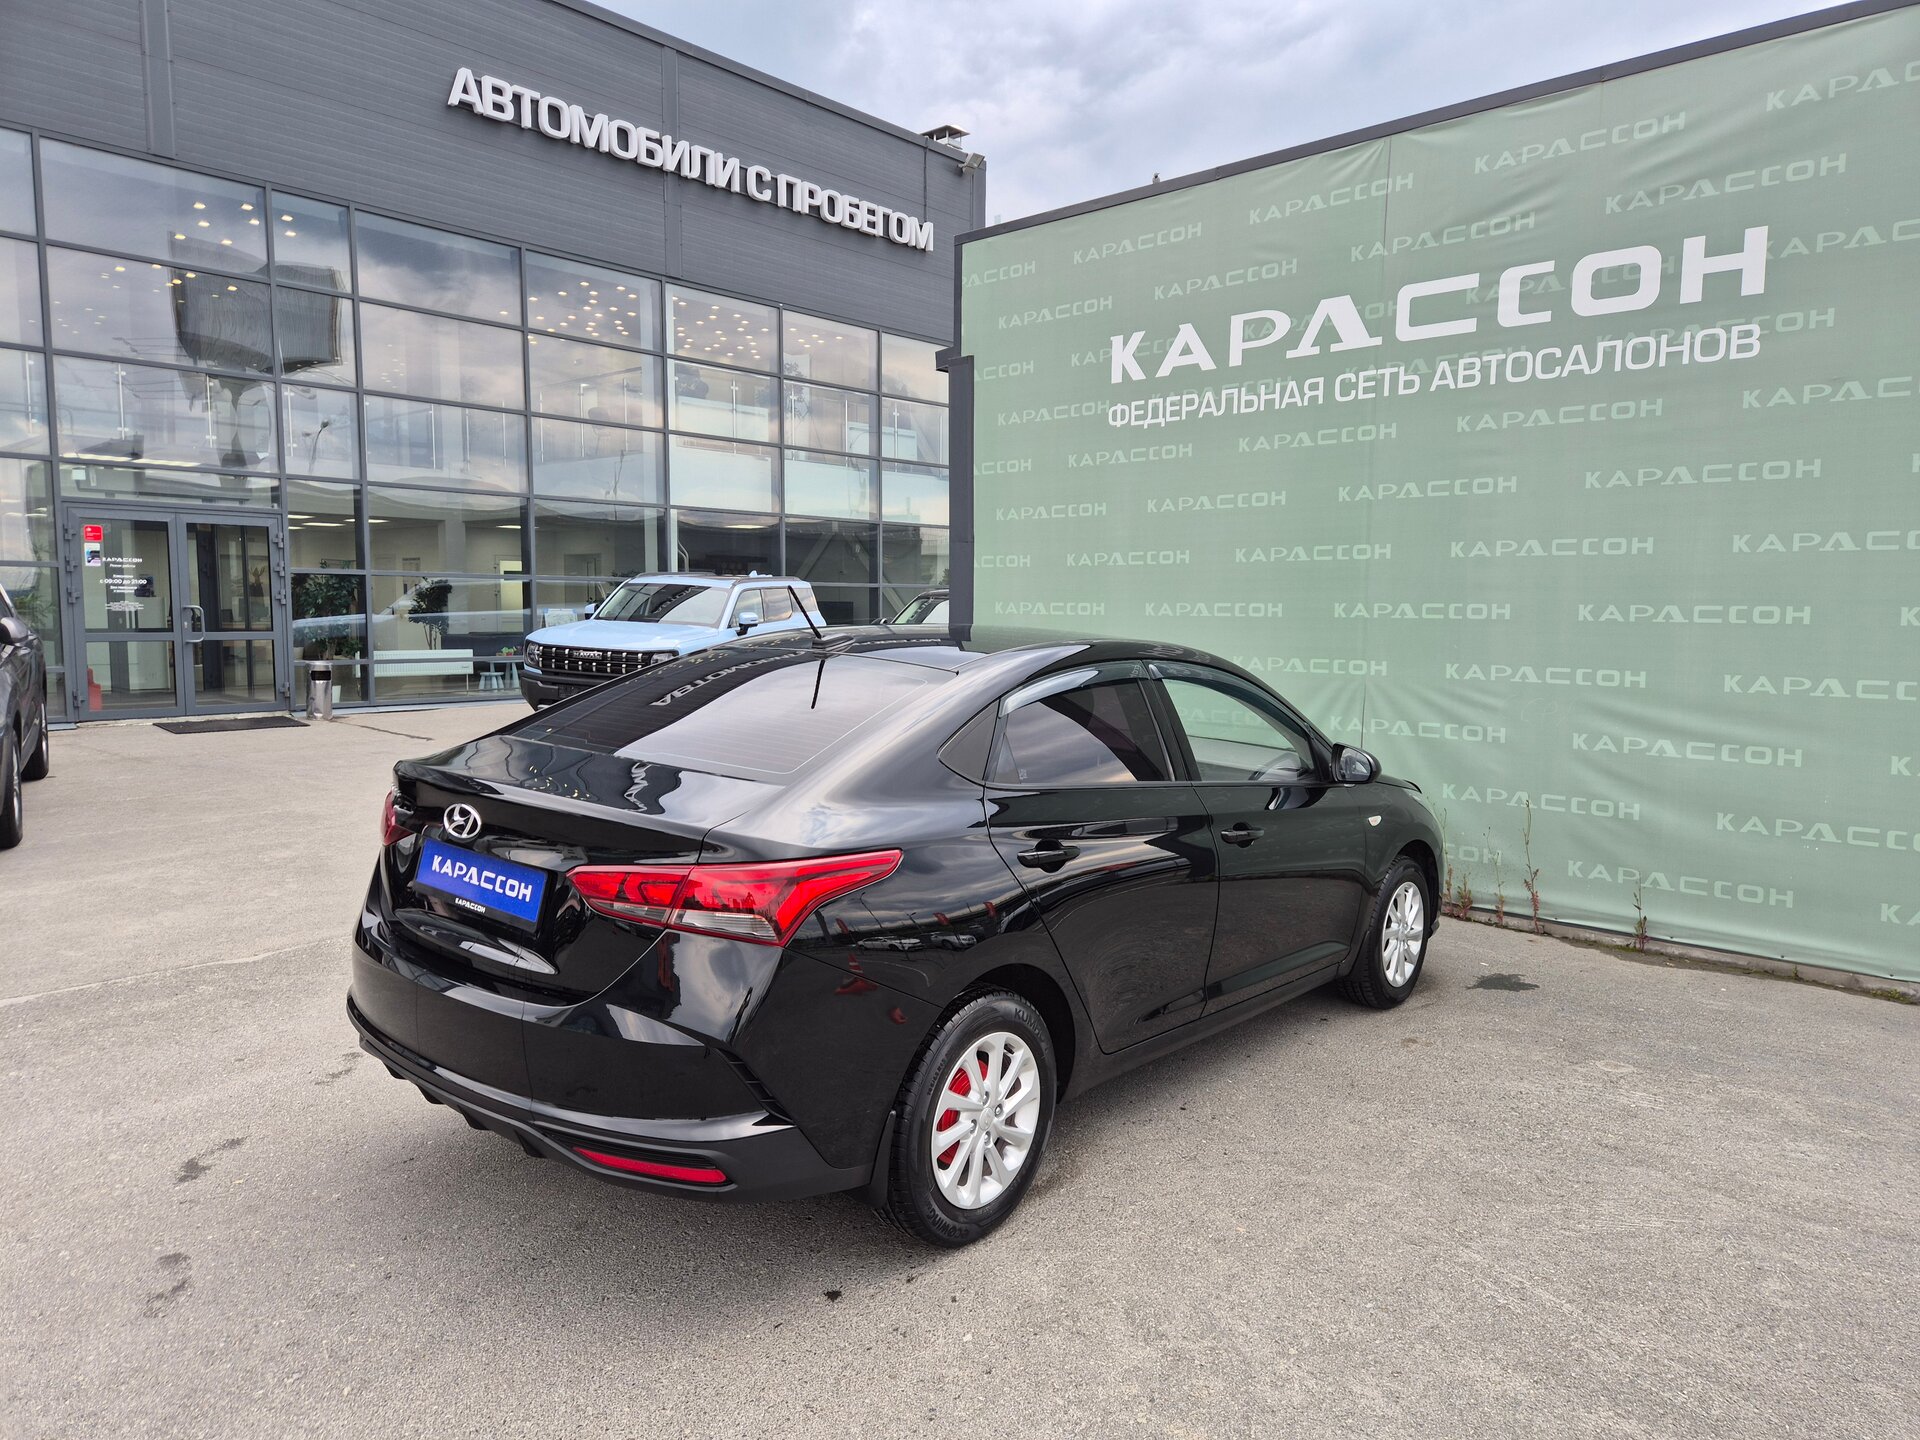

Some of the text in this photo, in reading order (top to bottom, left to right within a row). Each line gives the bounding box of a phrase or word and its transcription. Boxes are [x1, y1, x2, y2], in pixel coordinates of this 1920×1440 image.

[447, 67, 934, 252] АВТОМОБИЛИ С ПРОБЕГОМ
[1107, 323, 1762, 430] ФЕДЕРАЛЬНАЯ СЕТЬ АВТОСАЛОНОВ
